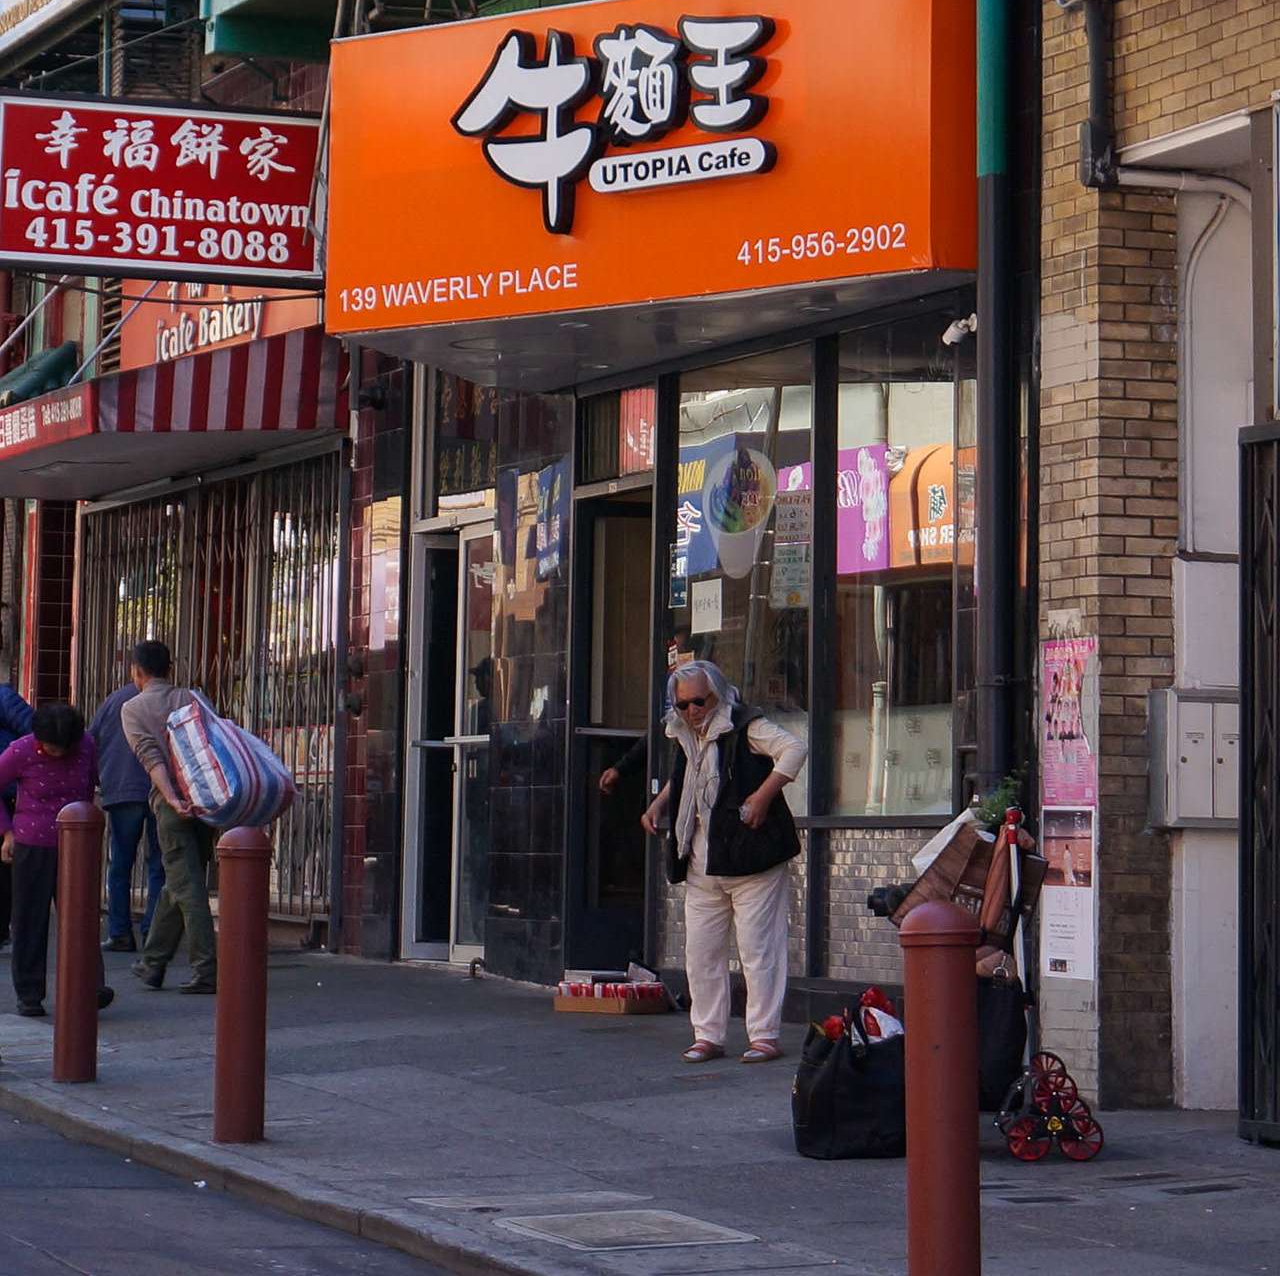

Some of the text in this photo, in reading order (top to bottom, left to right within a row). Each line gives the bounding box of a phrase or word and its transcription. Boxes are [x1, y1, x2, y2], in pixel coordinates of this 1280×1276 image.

[35, 110, 296, 182] 幸福餅家
[602, 146, 751, 185] UTOPIA Cafe
[130, 188, 310, 228] Chinatown
[24, 216, 290, 264] 415-391-8088
[737, 222, 907, 267] 415-956-2902
[338, 264, 578, 313] 139 WAVERLY PLACE
[156, 311, 196, 363] icafe
[197, 294, 265, 346] Bakery
